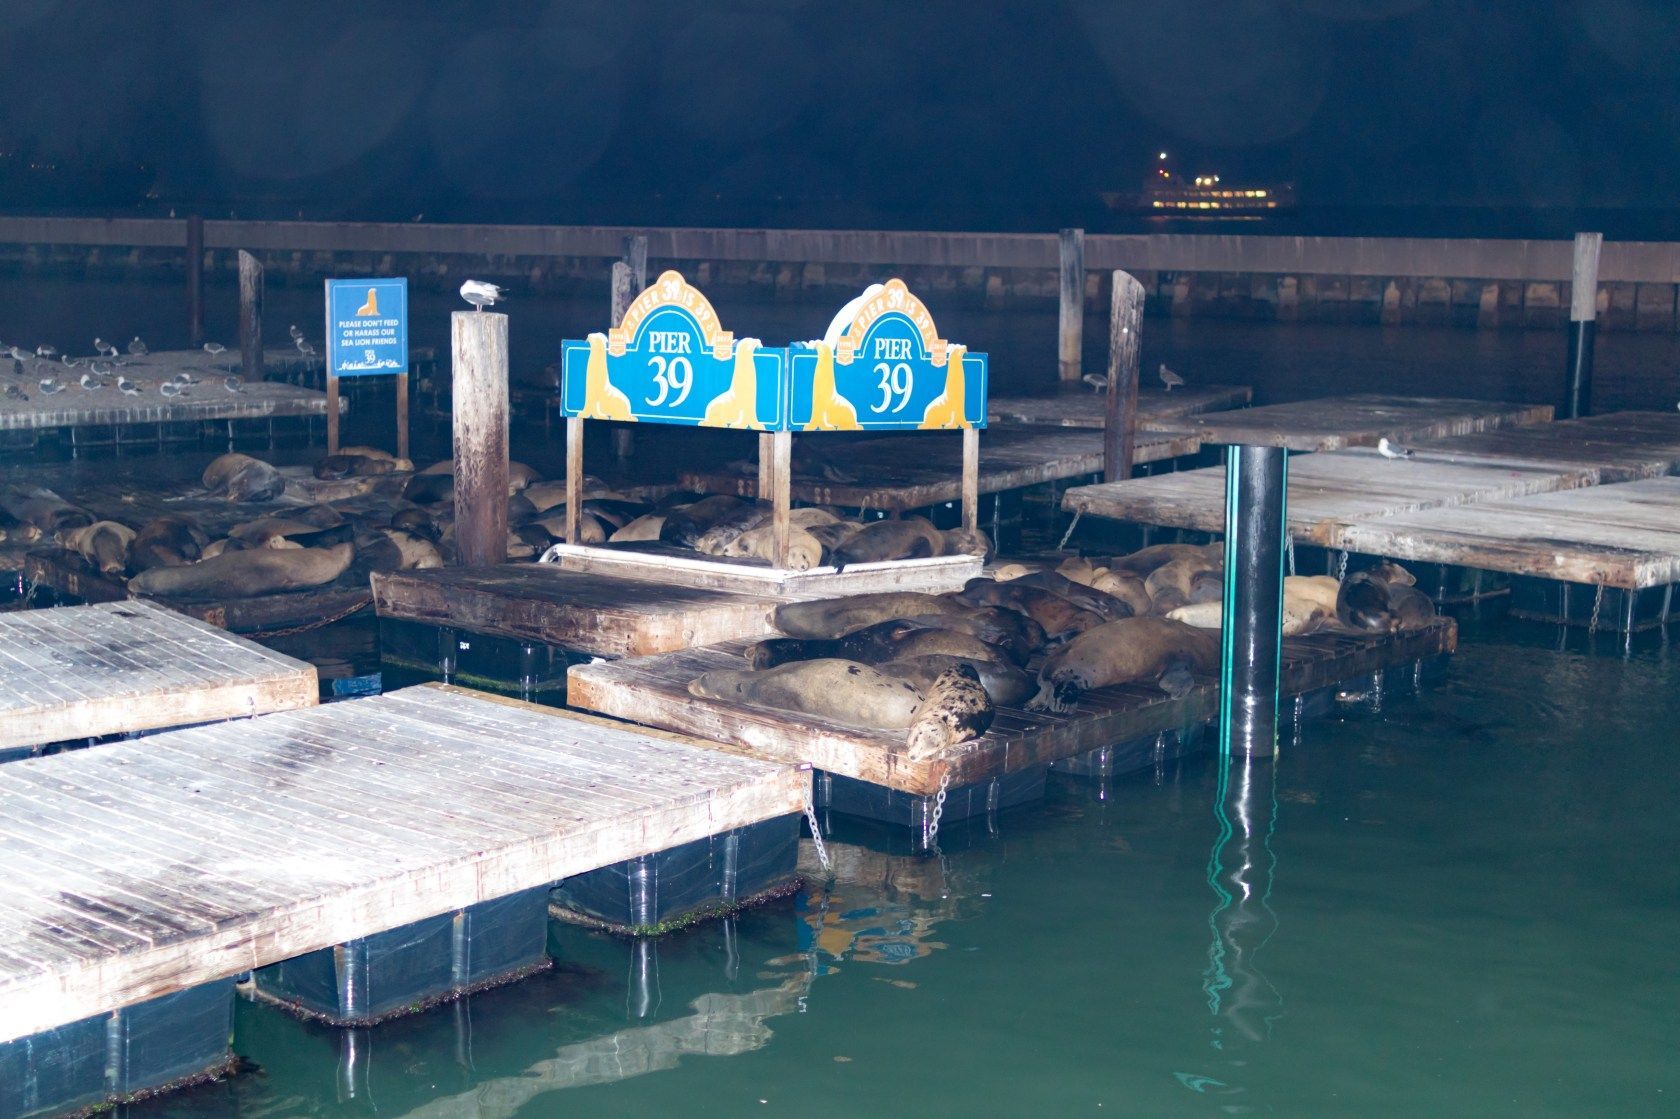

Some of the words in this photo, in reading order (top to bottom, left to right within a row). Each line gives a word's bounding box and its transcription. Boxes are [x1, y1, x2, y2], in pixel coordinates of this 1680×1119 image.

[631, 291, 660, 323] PIER
[662, 281, 681, 301] 39
[682, 290, 696, 307] IS
[695, 303, 712, 322] 39
[858, 299, 885, 329] PIER
[887, 288, 905, 310] 39
[339, 320, 361, 328] PLEASE
[354, 329, 380, 337] HARASS
[381, 328, 395, 336] OUR
[341, 339, 354, 347] SEA
[354, 338, 371, 346] LION
[371, 337, 397, 345] FRIENDS
[648, 331, 692, 354] PIER
[873, 337, 913, 360] PIER
[645, 355, 694, 408] 39
[870, 362, 914, 414] 39
